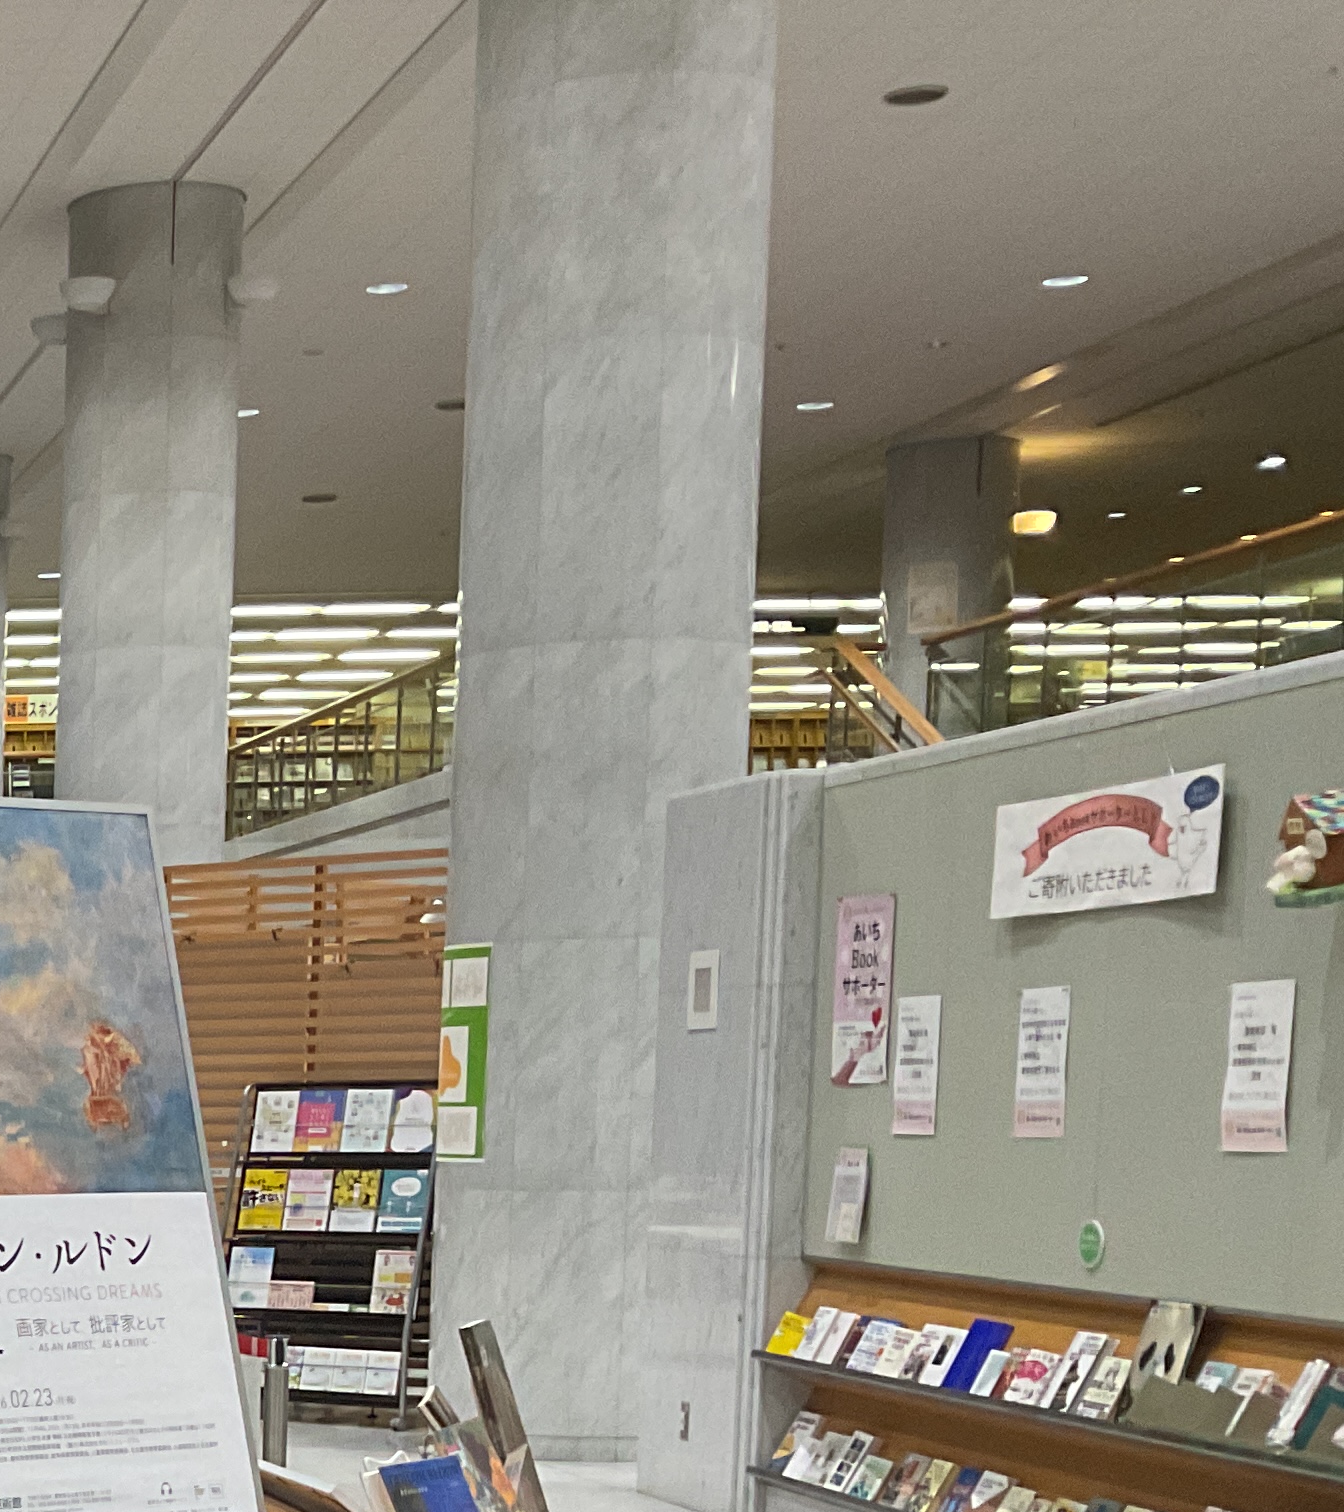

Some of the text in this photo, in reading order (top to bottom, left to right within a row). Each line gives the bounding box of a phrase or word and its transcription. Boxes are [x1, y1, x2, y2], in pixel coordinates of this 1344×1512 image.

[853, 921, 881, 942] あいち
[851, 949, 879, 969] Book
[7, 1285, 92, 1305] CROSSING
[97, 1282, 163, 1301] DREAMS
[15, 1318, 80, 1338] 画家として
[89, 1313, 166, 1335] 批評家として
